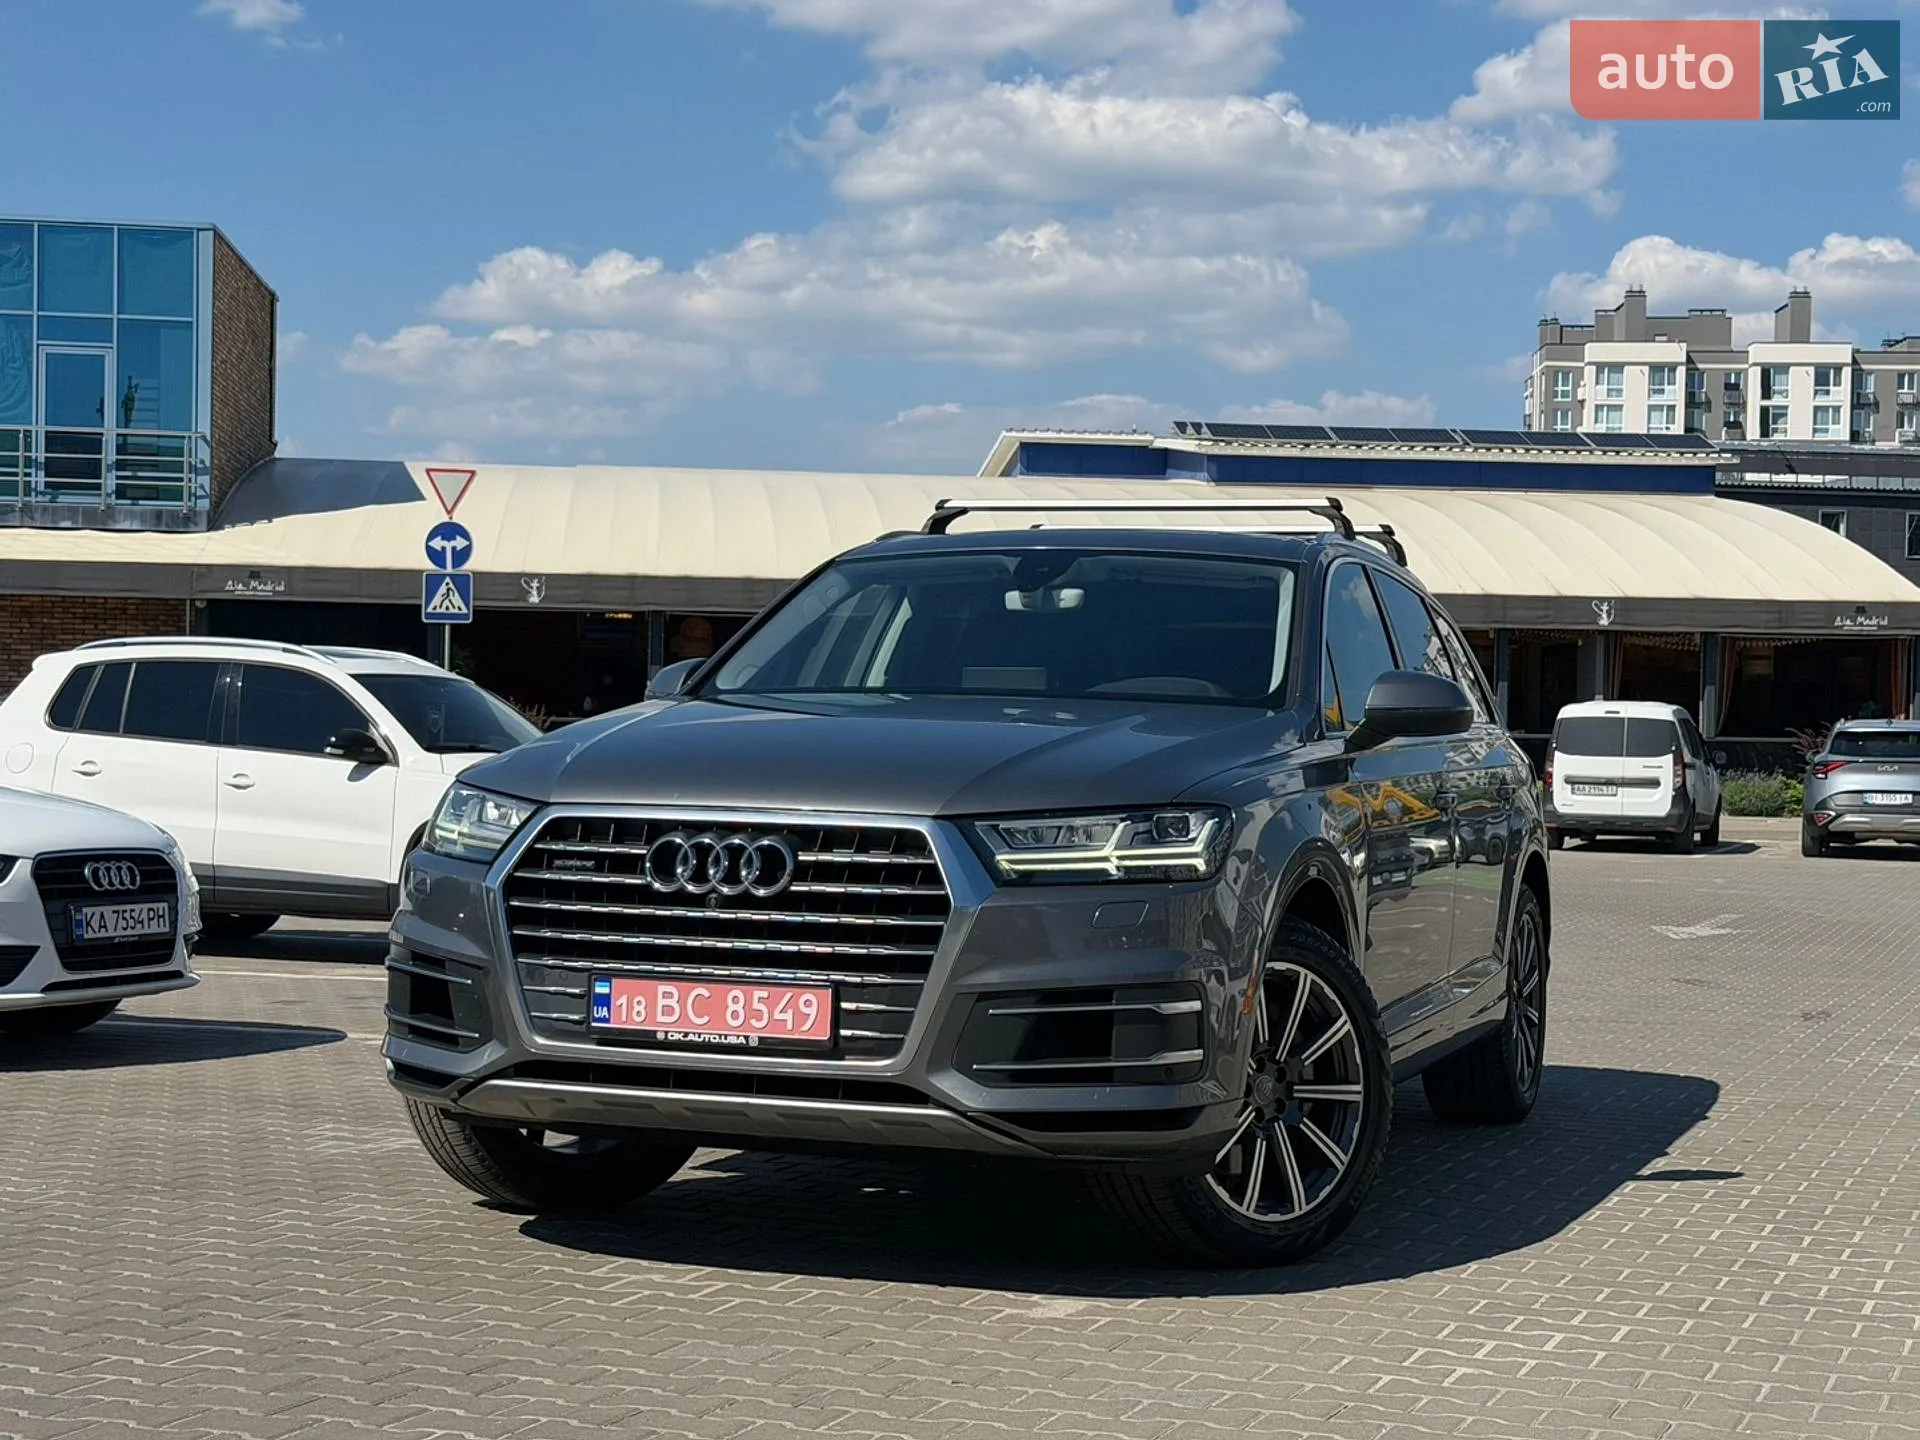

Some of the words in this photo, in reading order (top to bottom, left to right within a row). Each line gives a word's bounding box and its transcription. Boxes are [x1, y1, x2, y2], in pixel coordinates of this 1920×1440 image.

[84, 911, 109, 934] KA
[112, 908, 145, 933] 7554
[147, 906, 167, 929] PH
[593, 1006, 609, 1018] UA
[615, 994, 648, 1023] 18
[656, 985, 712, 1026] BC
[725, 989, 819, 1032] 8549
